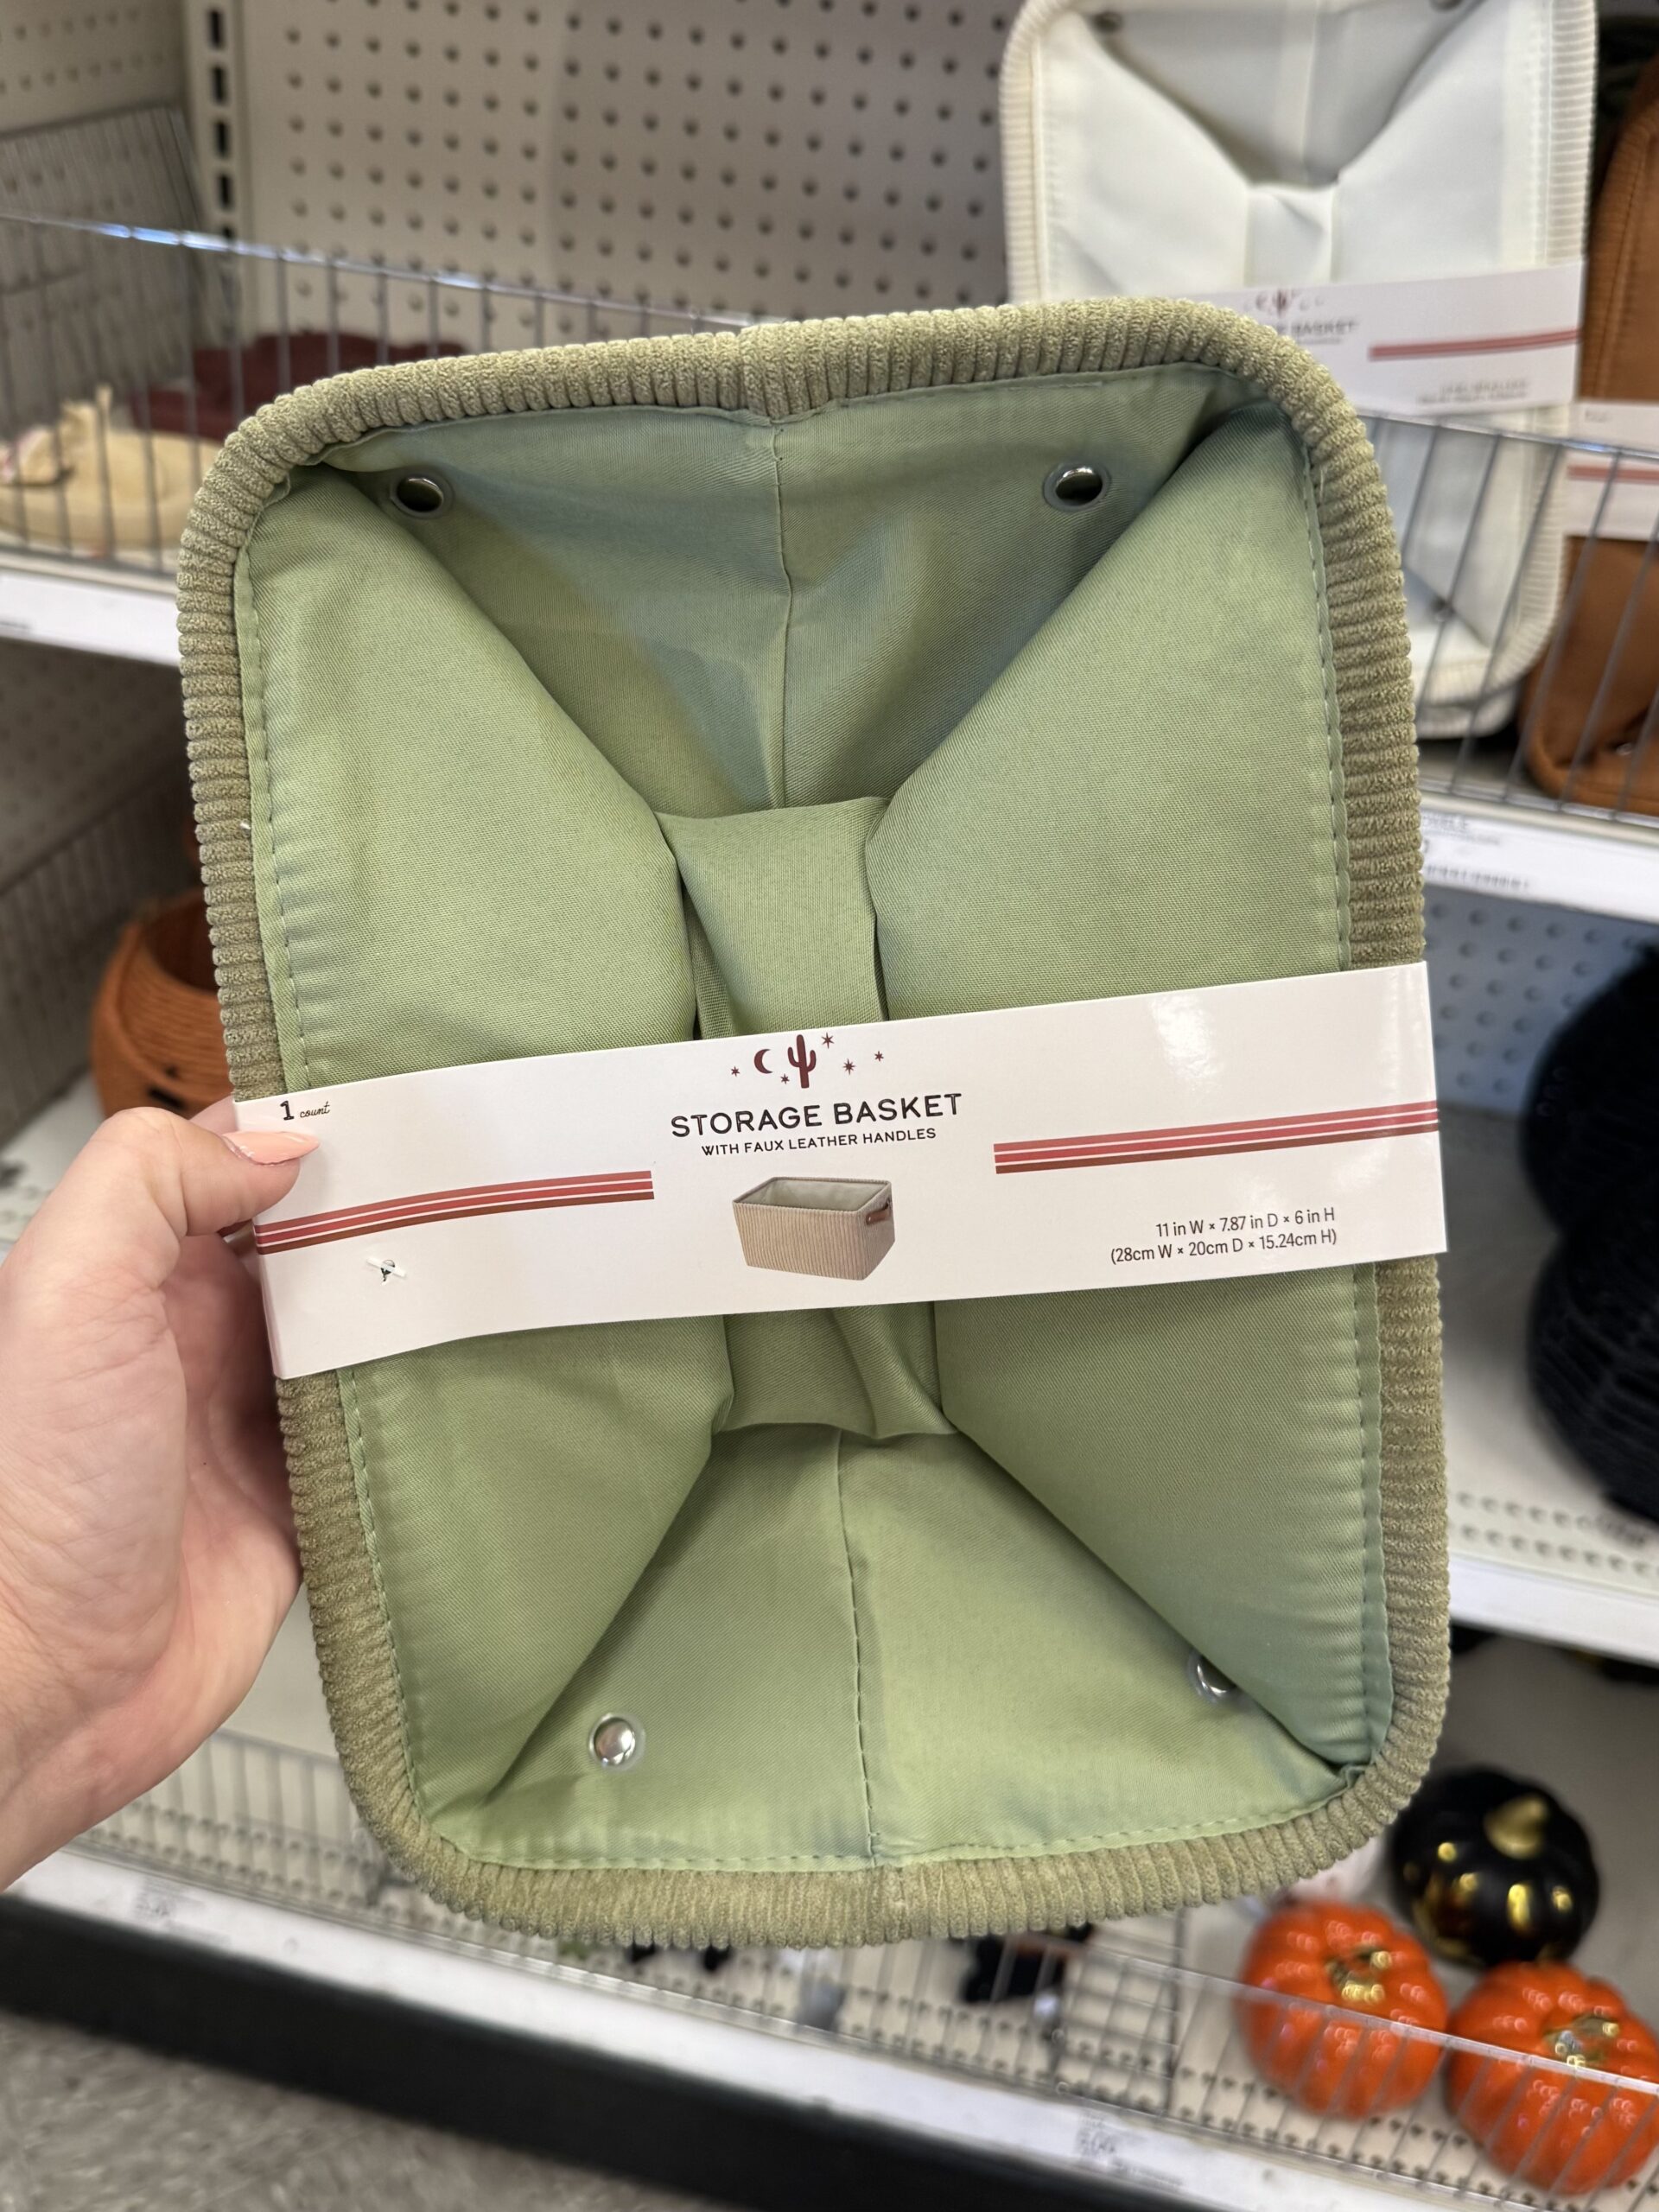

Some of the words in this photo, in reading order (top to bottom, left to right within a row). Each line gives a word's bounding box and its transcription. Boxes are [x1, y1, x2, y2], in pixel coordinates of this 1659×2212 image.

[279, 1100, 296, 1122] 1
[299, 1100, 331, 1118] count
[671, 1104, 823, 1138] STORAGE
[833, 1092, 963, 1125] BASKET
[701, 1142, 740, 1156] WITH
[744, 1140, 785, 1154] FAUX
[788, 1134, 858, 1150] LEATHER
[862, 1127, 937, 1145] HANDLES
[1155, 1222, 1169, 1237] 11
[1172, 1221, 1187, 1236] in
[1188, 1218, 1205, 1235] W
[1218, 1215, 1247, 1233] 7.87
[1249, 1214, 1264, 1230] in
[1267, 1212, 1279, 1228] D
[1294, 1210, 1304, 1225] 6
[1306, 1209, 1321, 1224] in
[1323, 1206, 1335, 1222] H
[1110, 1245, 1155, 1266] (28cm
[1157, 1243, 1173, 1259] W
[1188, 1241, 1229, 1257] 20cm
[1231, 1237, 1243, 1253] D
[1258, 1232, 1318, 1250] 15.24cm
[1319, 1228, 1338, 1246] H)
